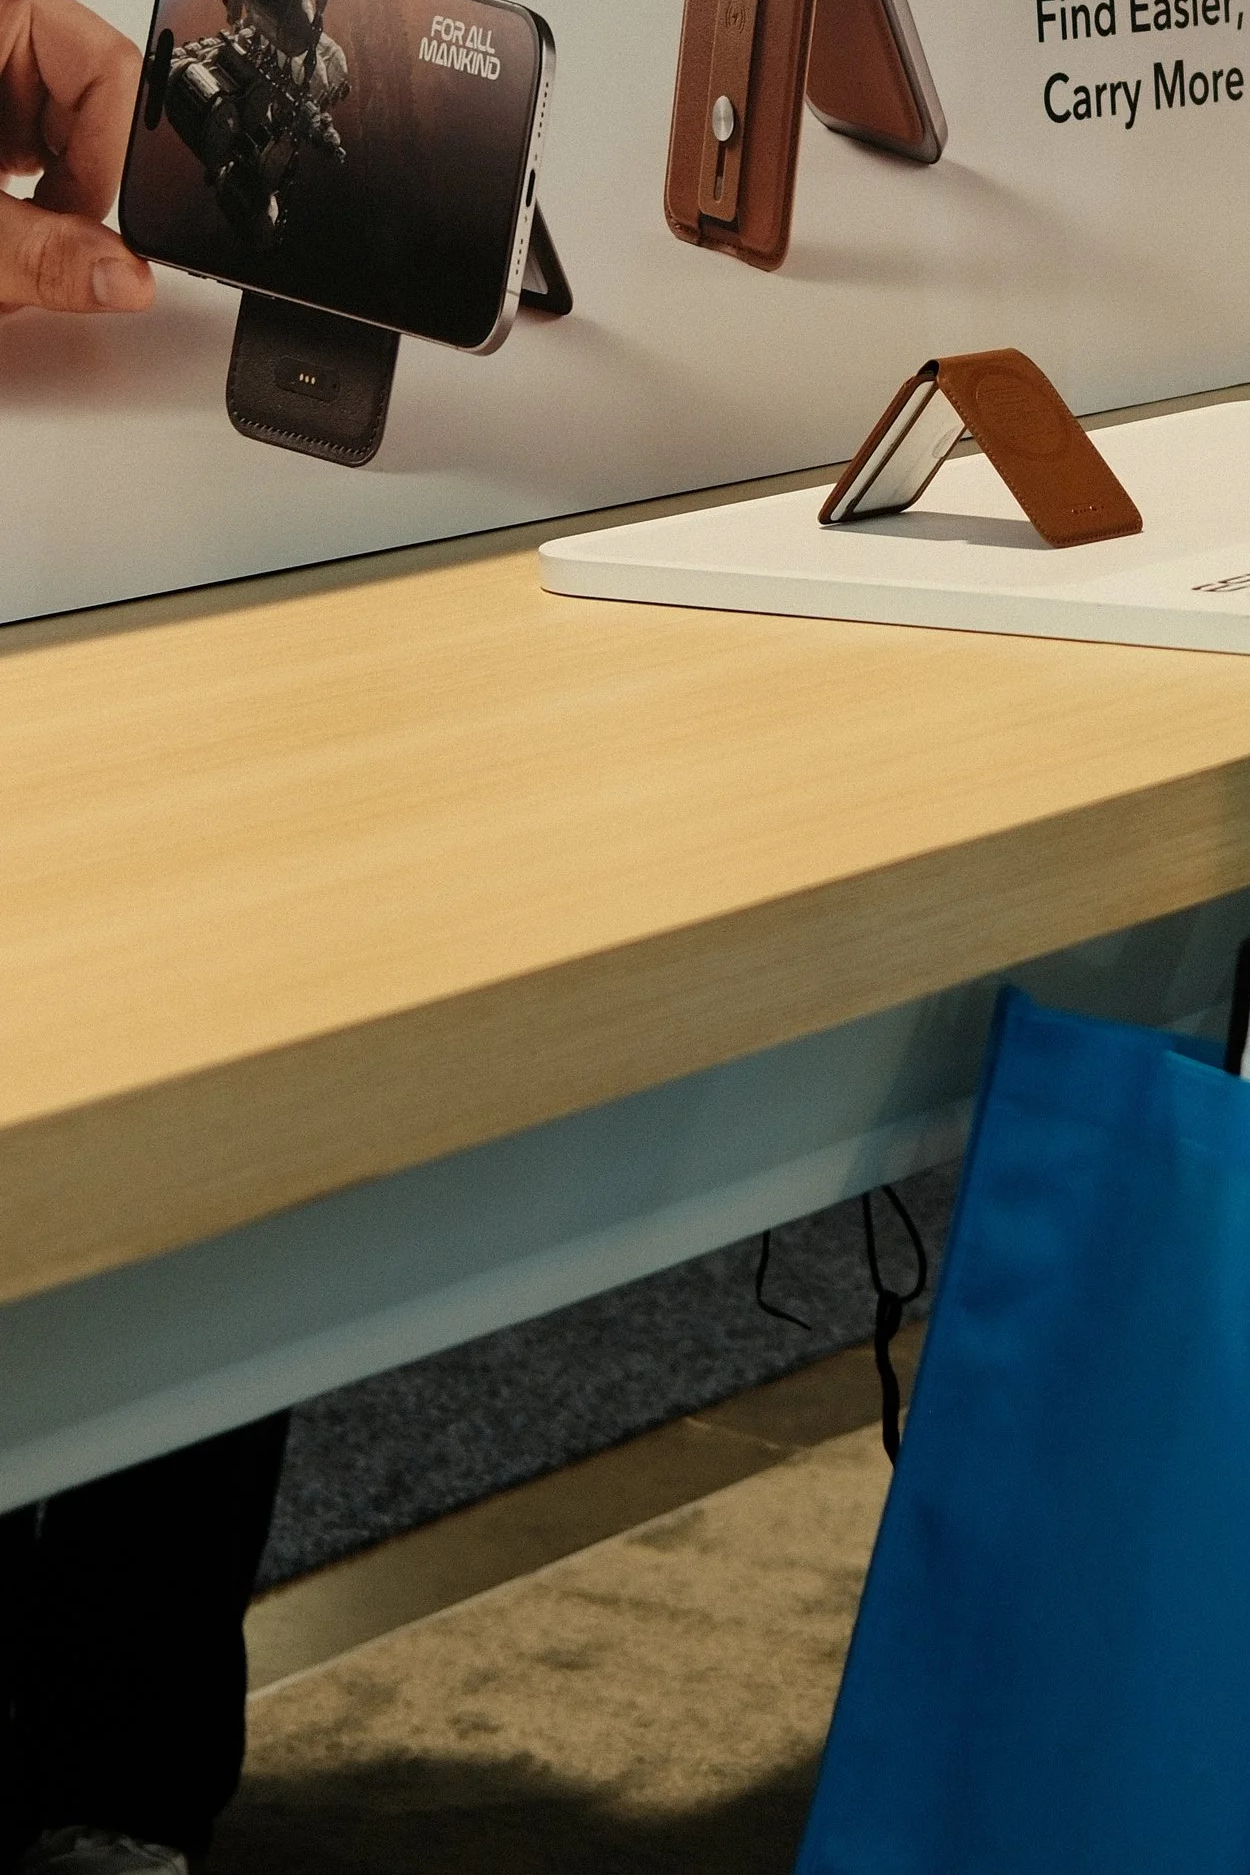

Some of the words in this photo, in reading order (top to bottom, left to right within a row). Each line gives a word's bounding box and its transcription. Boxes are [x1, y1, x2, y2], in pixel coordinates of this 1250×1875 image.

[431, 15, 466, 46] FOR
[465, 25, 496, 54] ALL
[418, 37, 501, 80] MANKIND
[1043, 72, 1142, 130] Carry
[1153, 59, 1245, 110] More
